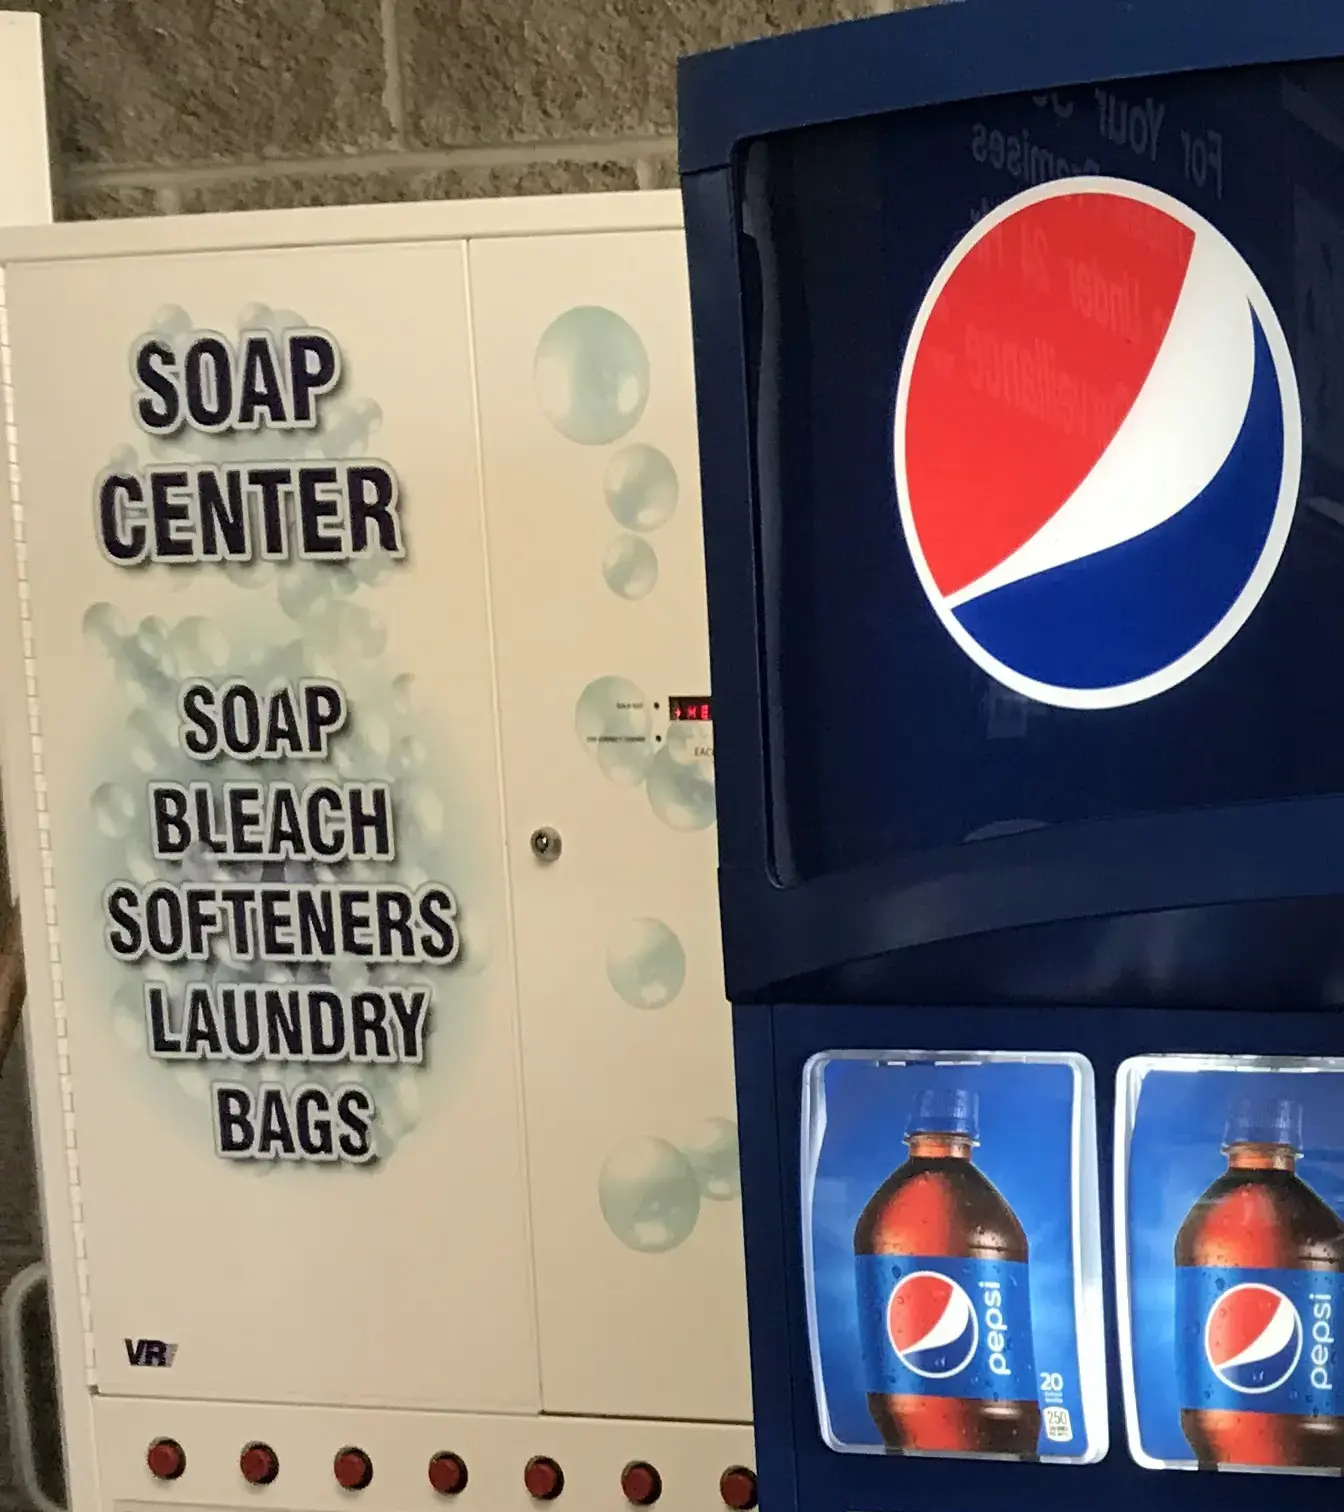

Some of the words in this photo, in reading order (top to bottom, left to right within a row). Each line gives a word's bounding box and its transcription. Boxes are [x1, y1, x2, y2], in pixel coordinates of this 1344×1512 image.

[136, 332, 338, 428] SOAP
[100, 466, 398, 559] CENTER
[182, 682, 344, 756] SOAP
[694, 748, 714, 756] EAC
[153, 786, 389, 856] BLEACH
[108, 889, 456, 959] SOFTENERS
[149, 988, 429, 1056] LAUNDRY
[218, 1088, 373, 1156] BAGS
[978, 1281, 1010, 1376] pepsi
[1309, 1293, 1334, 1390] pepsi
[1040, 1372, 1062, 1390] 20
[1047, 1411, 1067, 1425] 250
